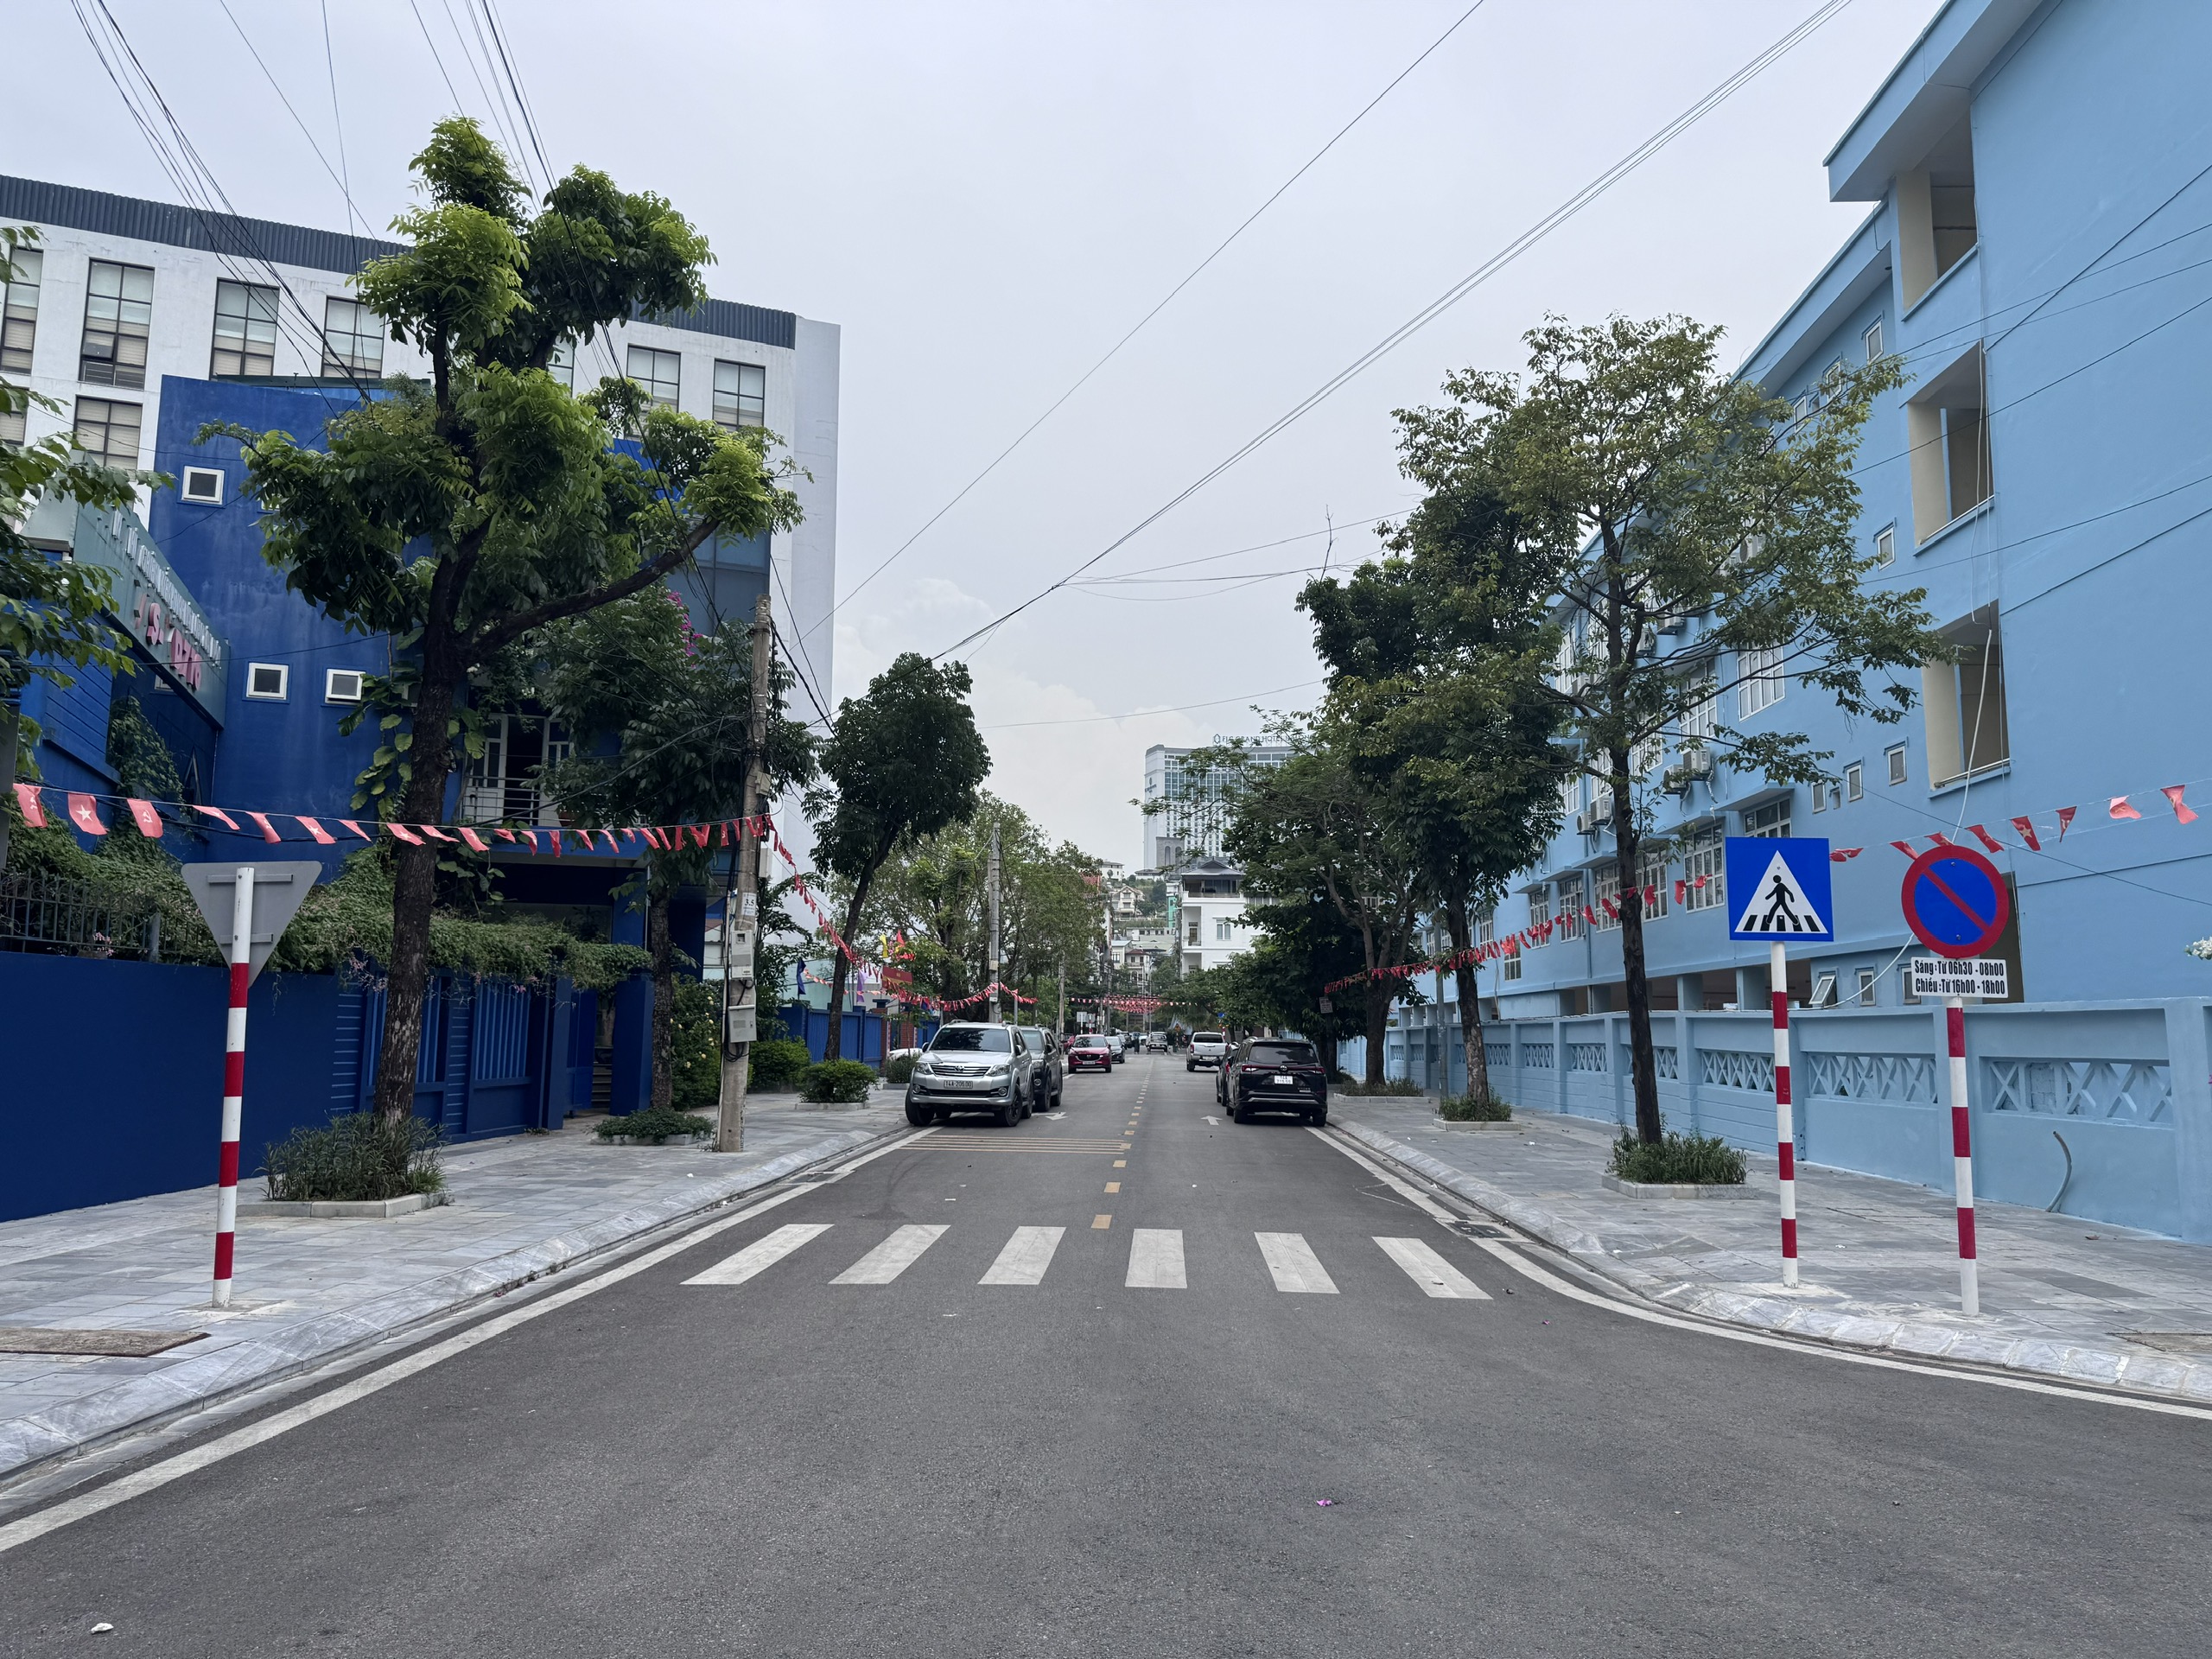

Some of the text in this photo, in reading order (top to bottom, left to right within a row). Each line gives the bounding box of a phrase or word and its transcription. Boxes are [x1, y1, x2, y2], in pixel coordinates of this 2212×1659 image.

[744, 898, 754, 906] 3.5
[1948, 961, 1973, 976] 06h30
[1979, 963, 2004, 976] 08h00
[1952, 979, 1976, 994] 16h00
[1981, 980, 2005, 995] 18h00
